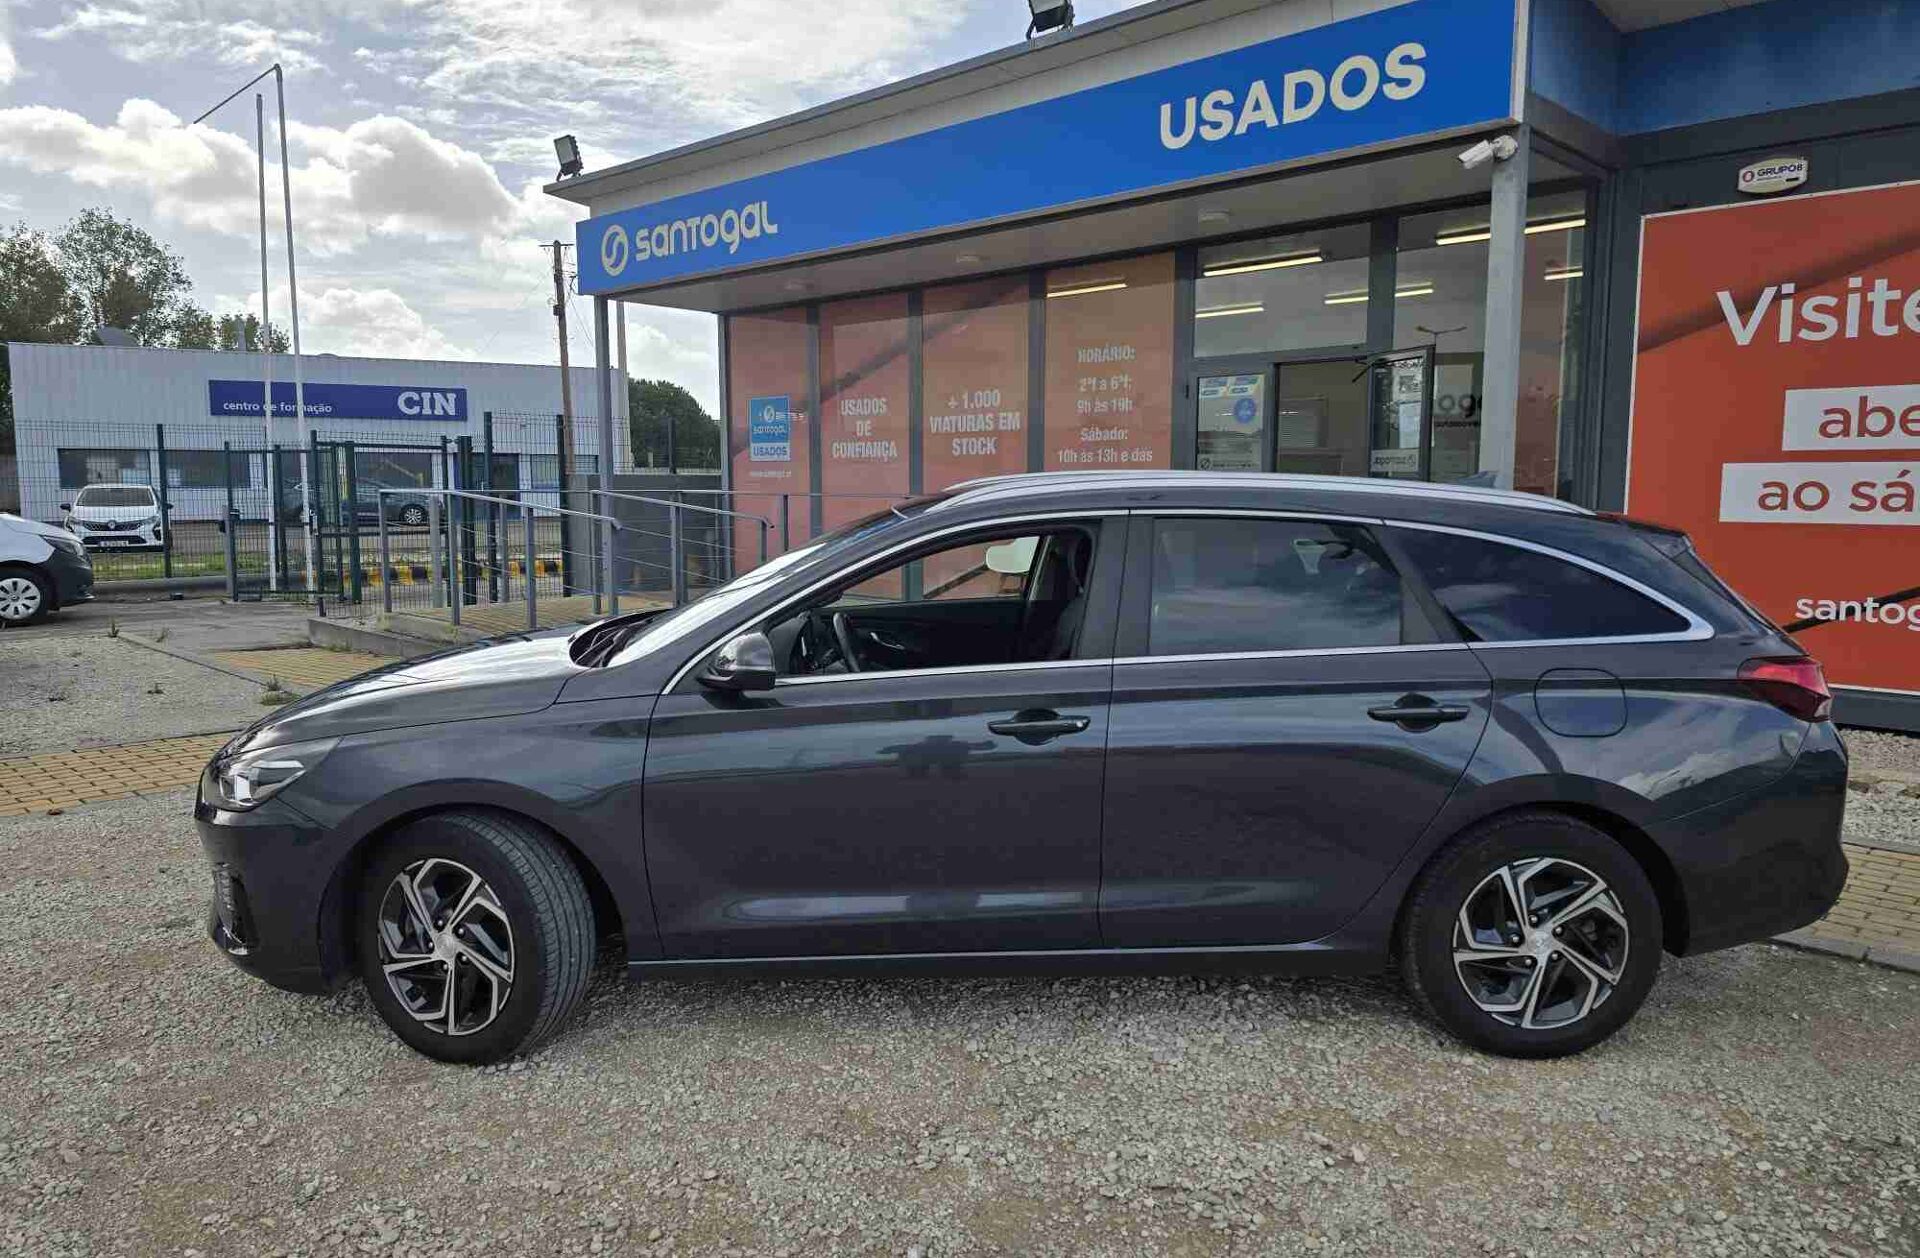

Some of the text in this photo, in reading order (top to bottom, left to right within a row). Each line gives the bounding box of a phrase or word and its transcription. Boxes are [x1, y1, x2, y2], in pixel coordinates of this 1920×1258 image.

[1160, 42, 1427, 150] USADOS
[1077, 343, 1136, 363] HORÁRIO:
[223, 402, 260, 411] centro
[280, 402, 332, 414] foração
[397, 391, 457, 416] CIN
[841, 398, 888, 416] USADOS
[963, 389, 1001, 409] 1.000
[856, 420, 873, 437] DE
[930, 411, 1020, 433] VIATURAS EM
[1080, 425, 1128, 441] Sábado:
[753, 445, 788, 457] USADOS
[832, 440, 898, 463] CONFIANÇA
[952, 437, 997, 456] STOCK
[1058, 449, 1078, 463] 10h
[1098, 448, 1118, 463] 13h
[1121, 452, 1131, 462] e
[1757, 480, 1830, 512] ao
